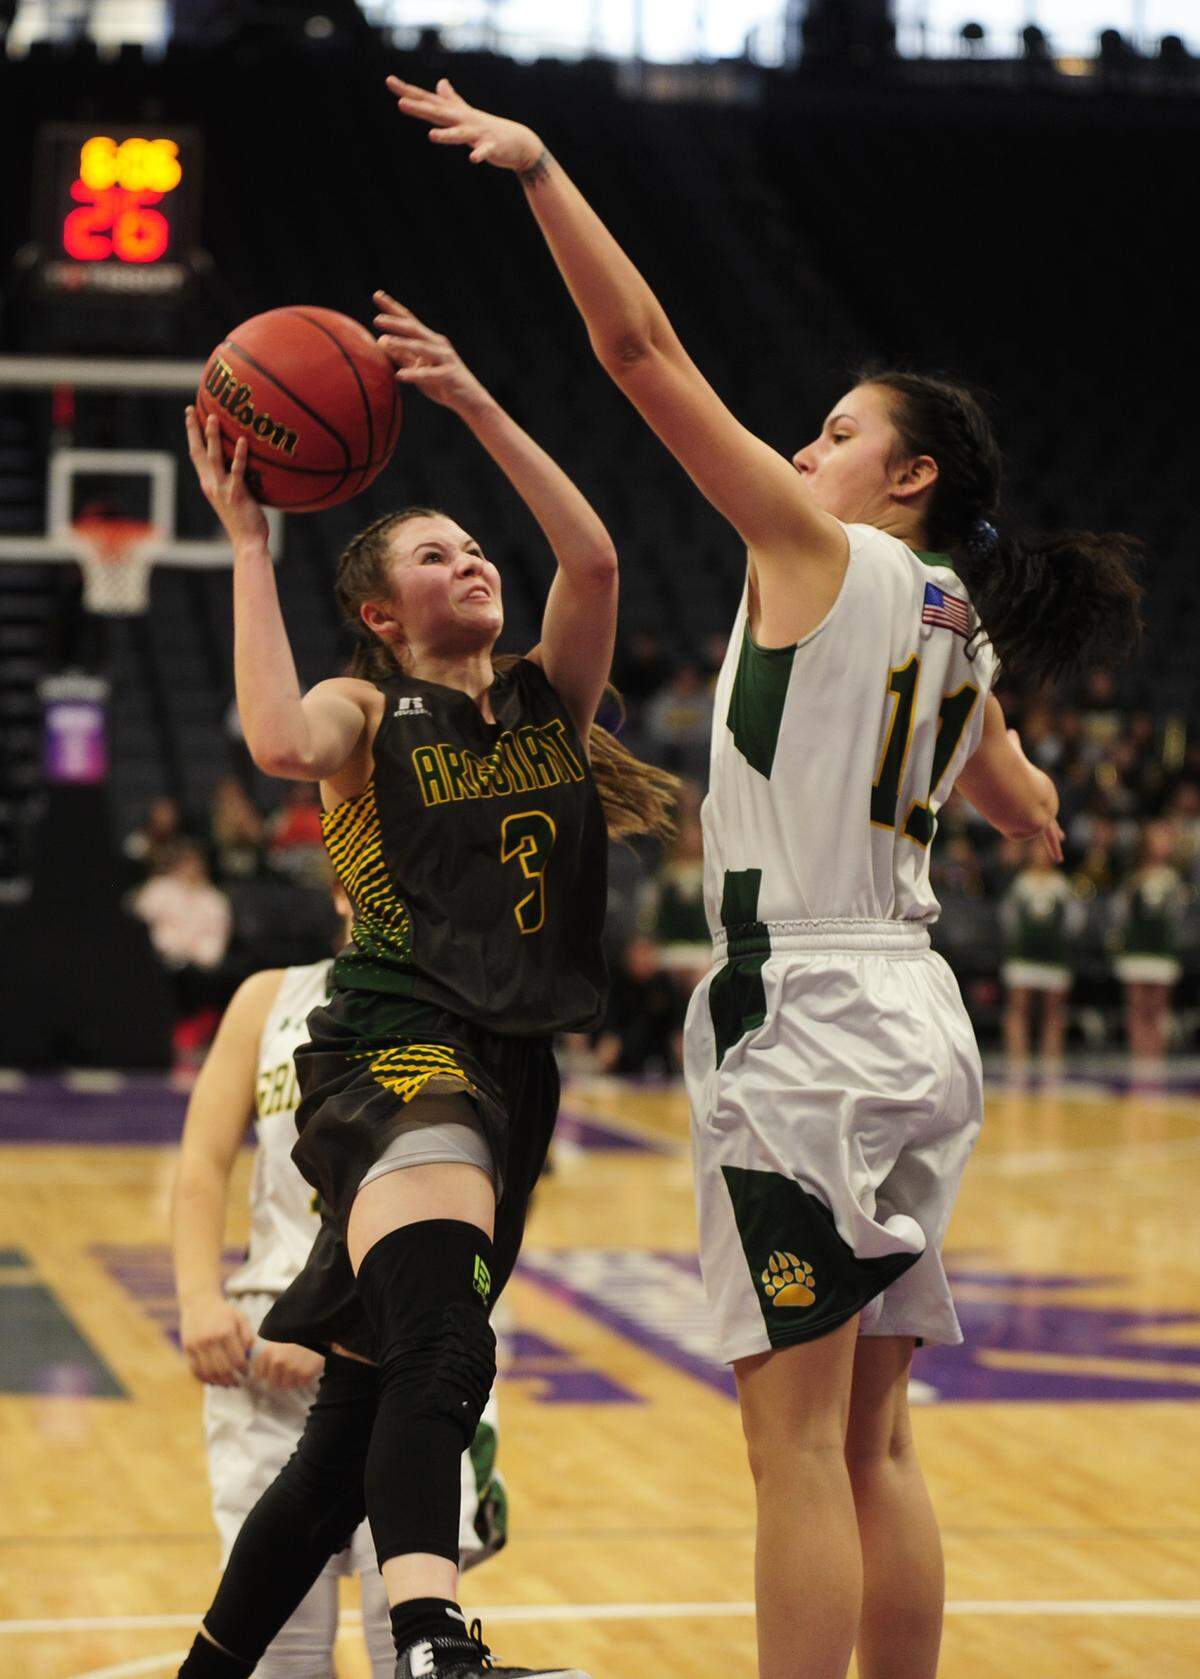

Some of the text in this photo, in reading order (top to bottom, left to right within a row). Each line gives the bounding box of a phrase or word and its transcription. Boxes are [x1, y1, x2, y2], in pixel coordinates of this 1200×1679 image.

[204, 356, 300, 458] Wilson
[868, 653, 980, 851] 11
[501, 810, 557, 934] 3
